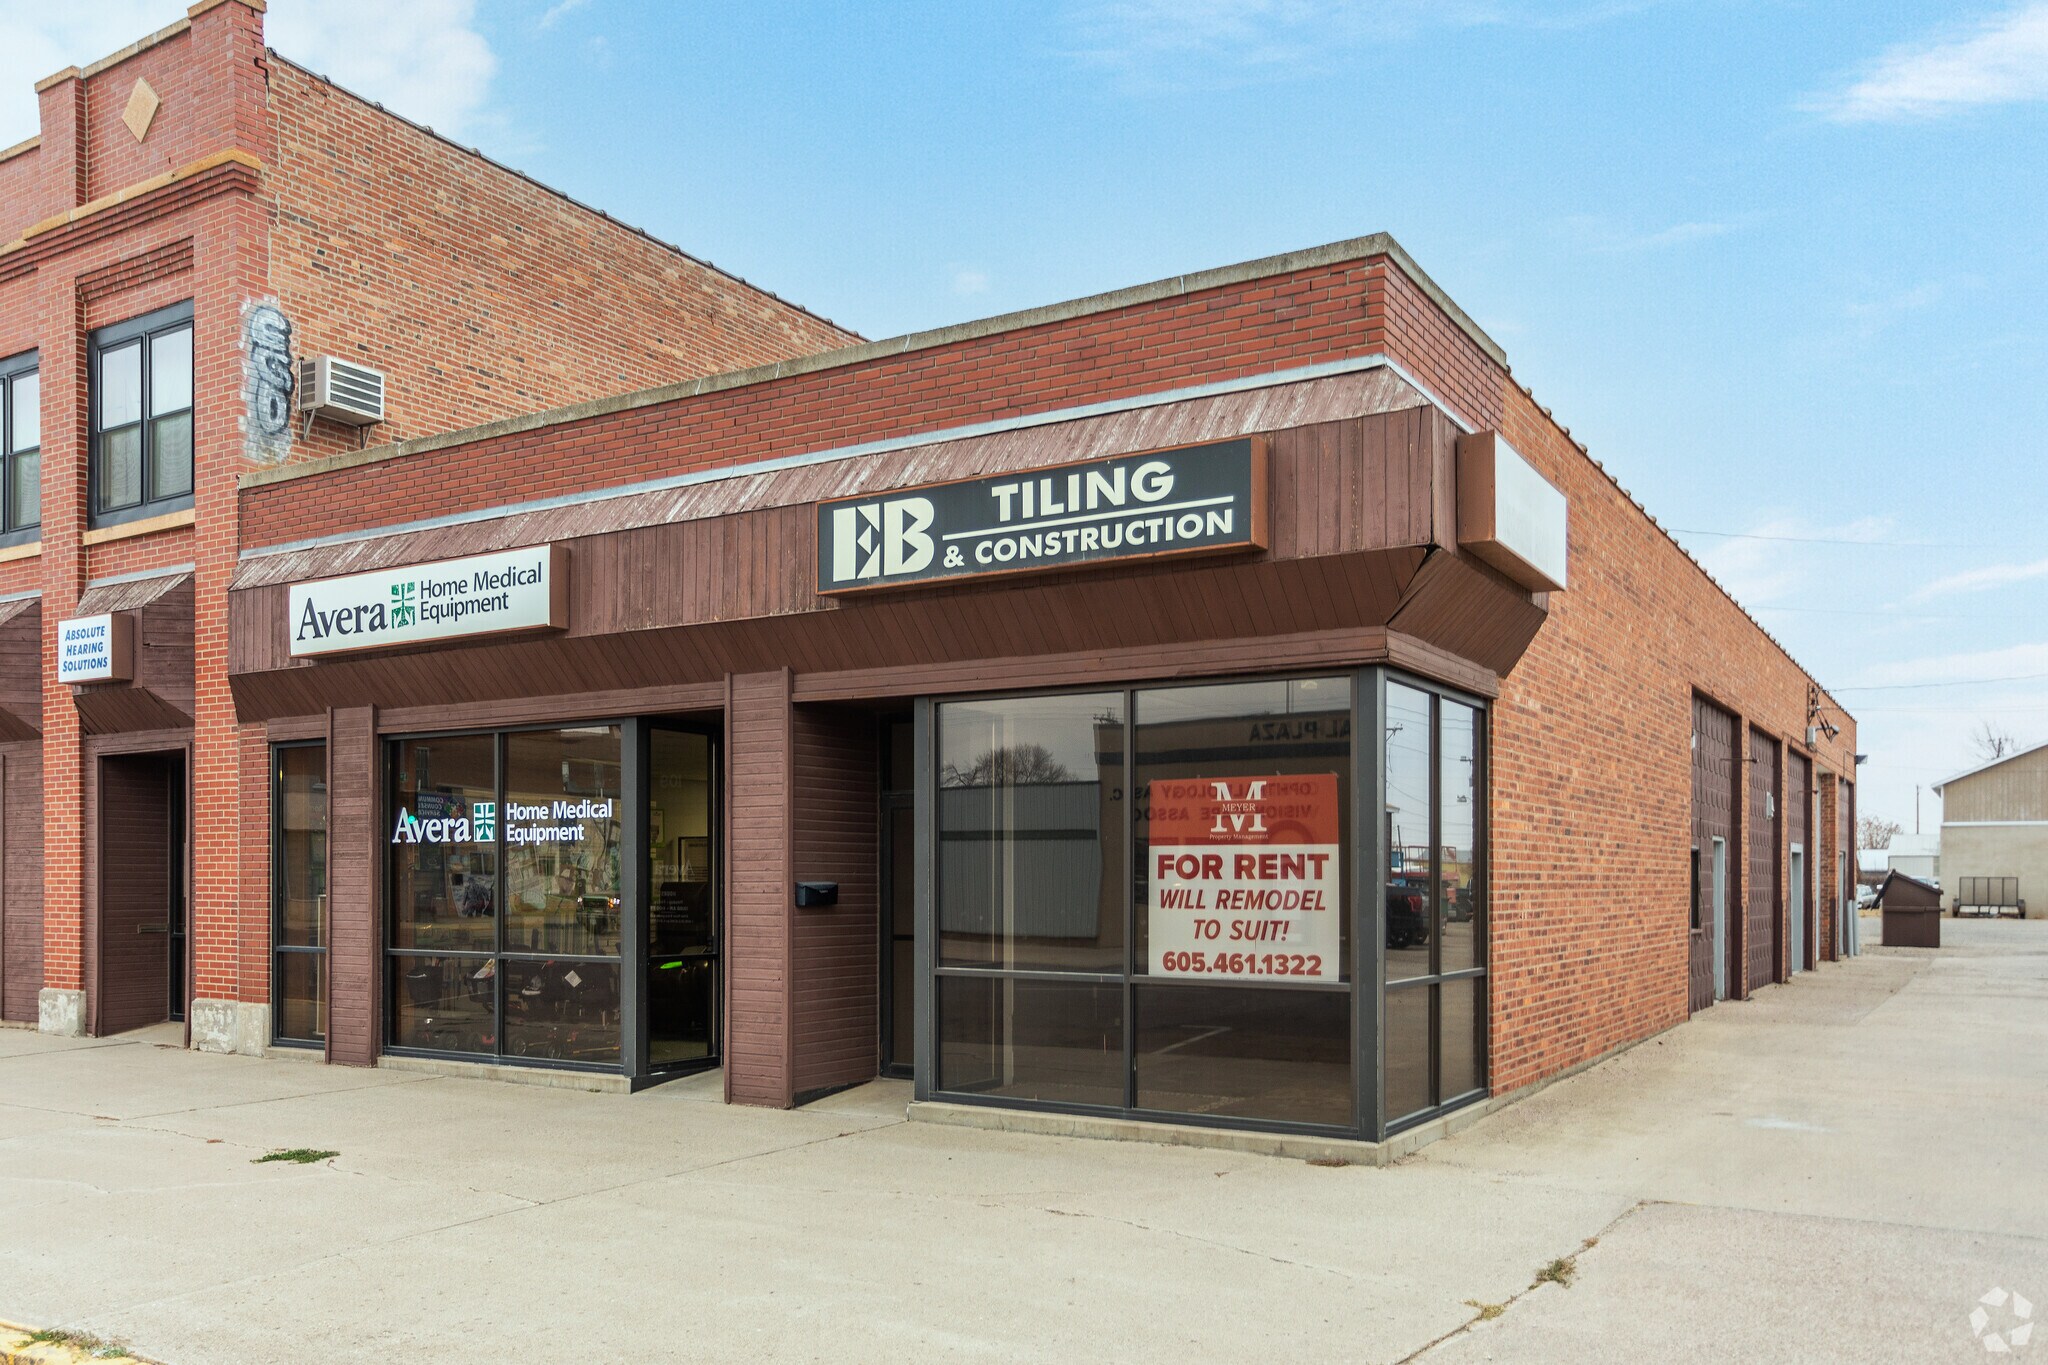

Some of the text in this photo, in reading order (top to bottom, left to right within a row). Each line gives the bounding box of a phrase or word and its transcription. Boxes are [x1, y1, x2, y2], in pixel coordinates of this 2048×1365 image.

[991, 461, 1174, 522] TILING
[832, 497, 935, 582] EB
[942, 508, 1233, 568] & CONSTRUCTION
[420, 562, 542, 599] Home Medical
[296, 597, 389, 641] Avera
[420, 592, 509, 624] Equipment
[65, 626, 105, 641] ABSOLUTE
[66, 642, 103, 656] HEARING
[62, 657, 108, 672] SOLUTIONS
[506, 798, 613, 821] Home Medical
[1222, 803, 1256, 812] MEYER
[392, 807, 472, 844] Avera
[506, 824, 585, 846] Equipment
[1209, 833, 1269, 841] Property Management
[1157, 853, 1330, 880] FOR RENT
[1160, 889, 1326, 911] WILL REMODEL
[1193, 919, 1290, 941] TO SUIT!
[1162, 951, 1322, 976] 605.461.1322
